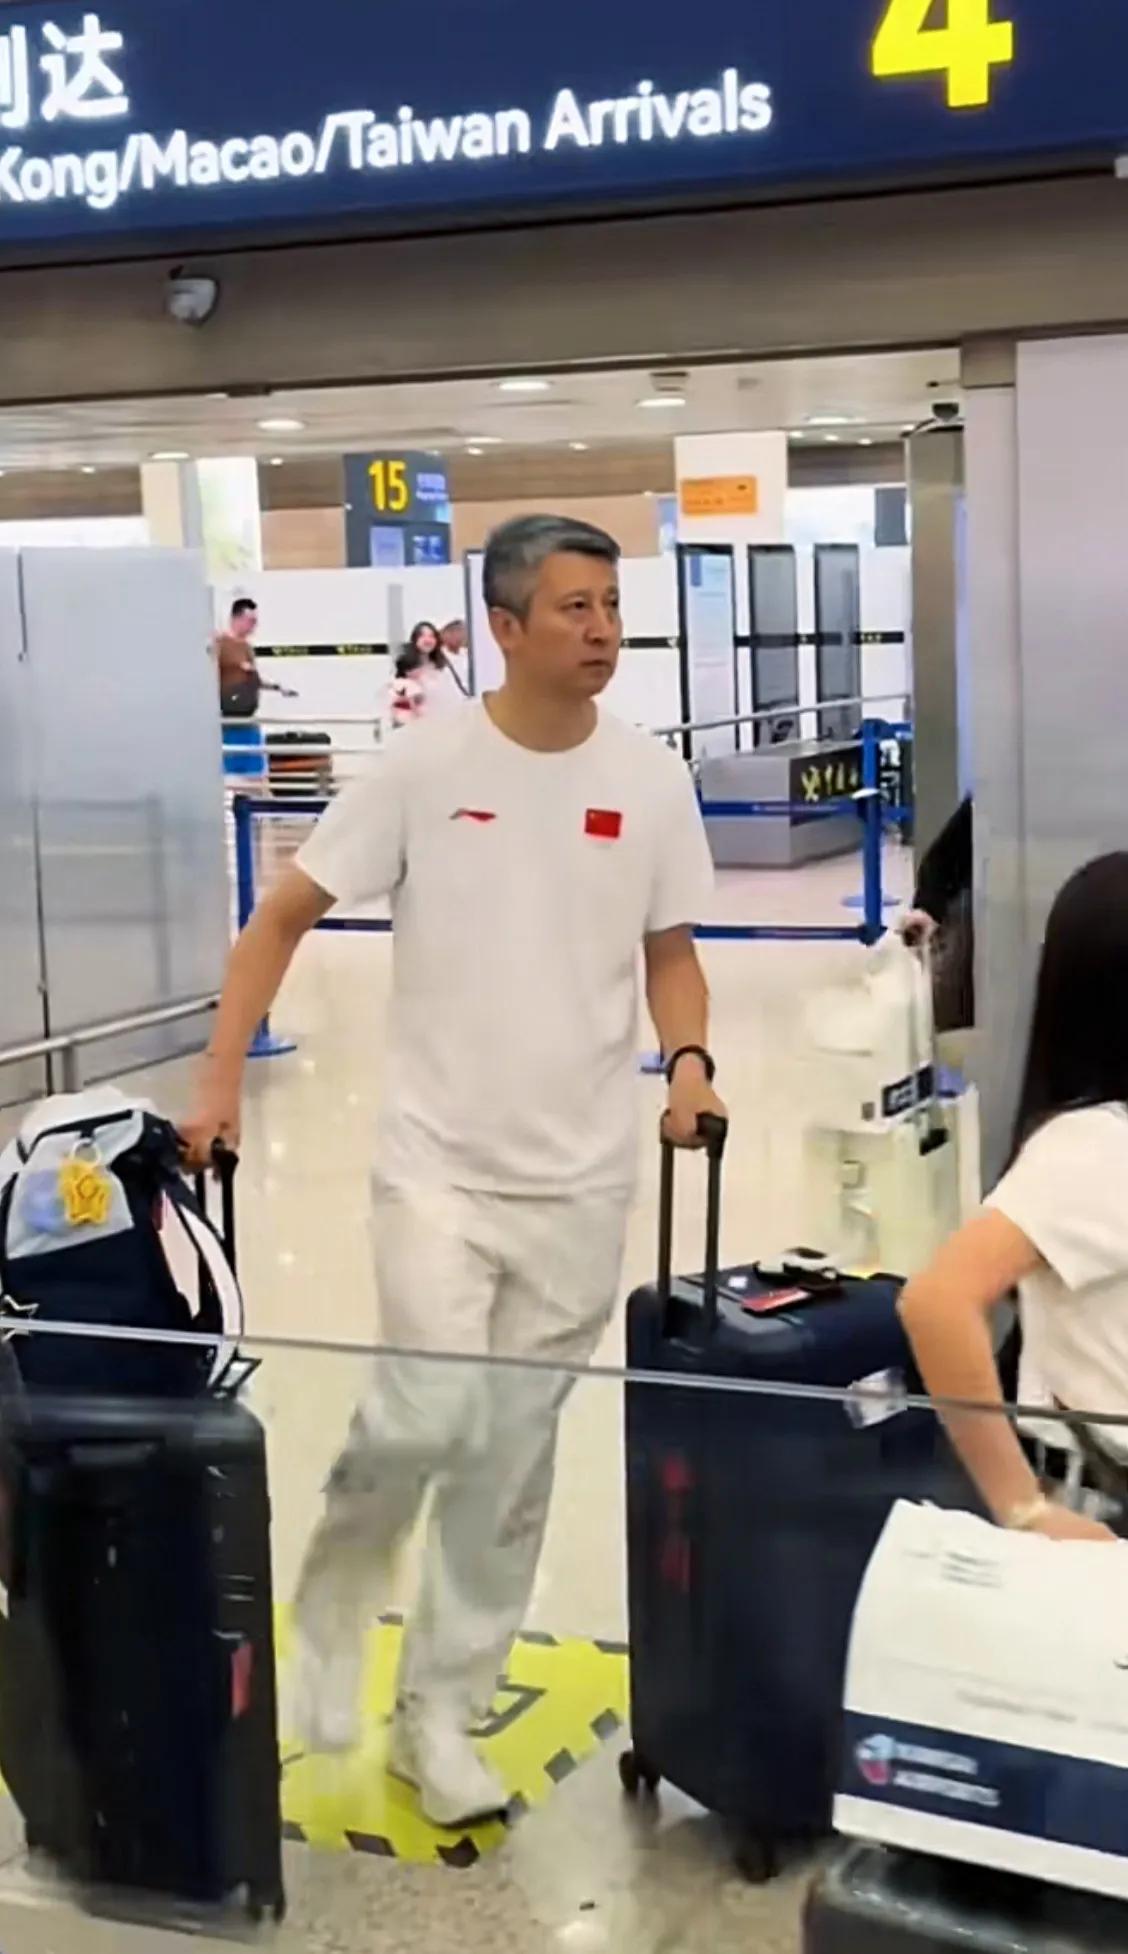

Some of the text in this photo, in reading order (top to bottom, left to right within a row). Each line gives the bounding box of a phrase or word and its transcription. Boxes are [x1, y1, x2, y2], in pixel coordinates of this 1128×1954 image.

[872, 0, 1013, 108] 4
[544, 68, 773, 151] Arrivals
[368, 459, 409, 512] 15
